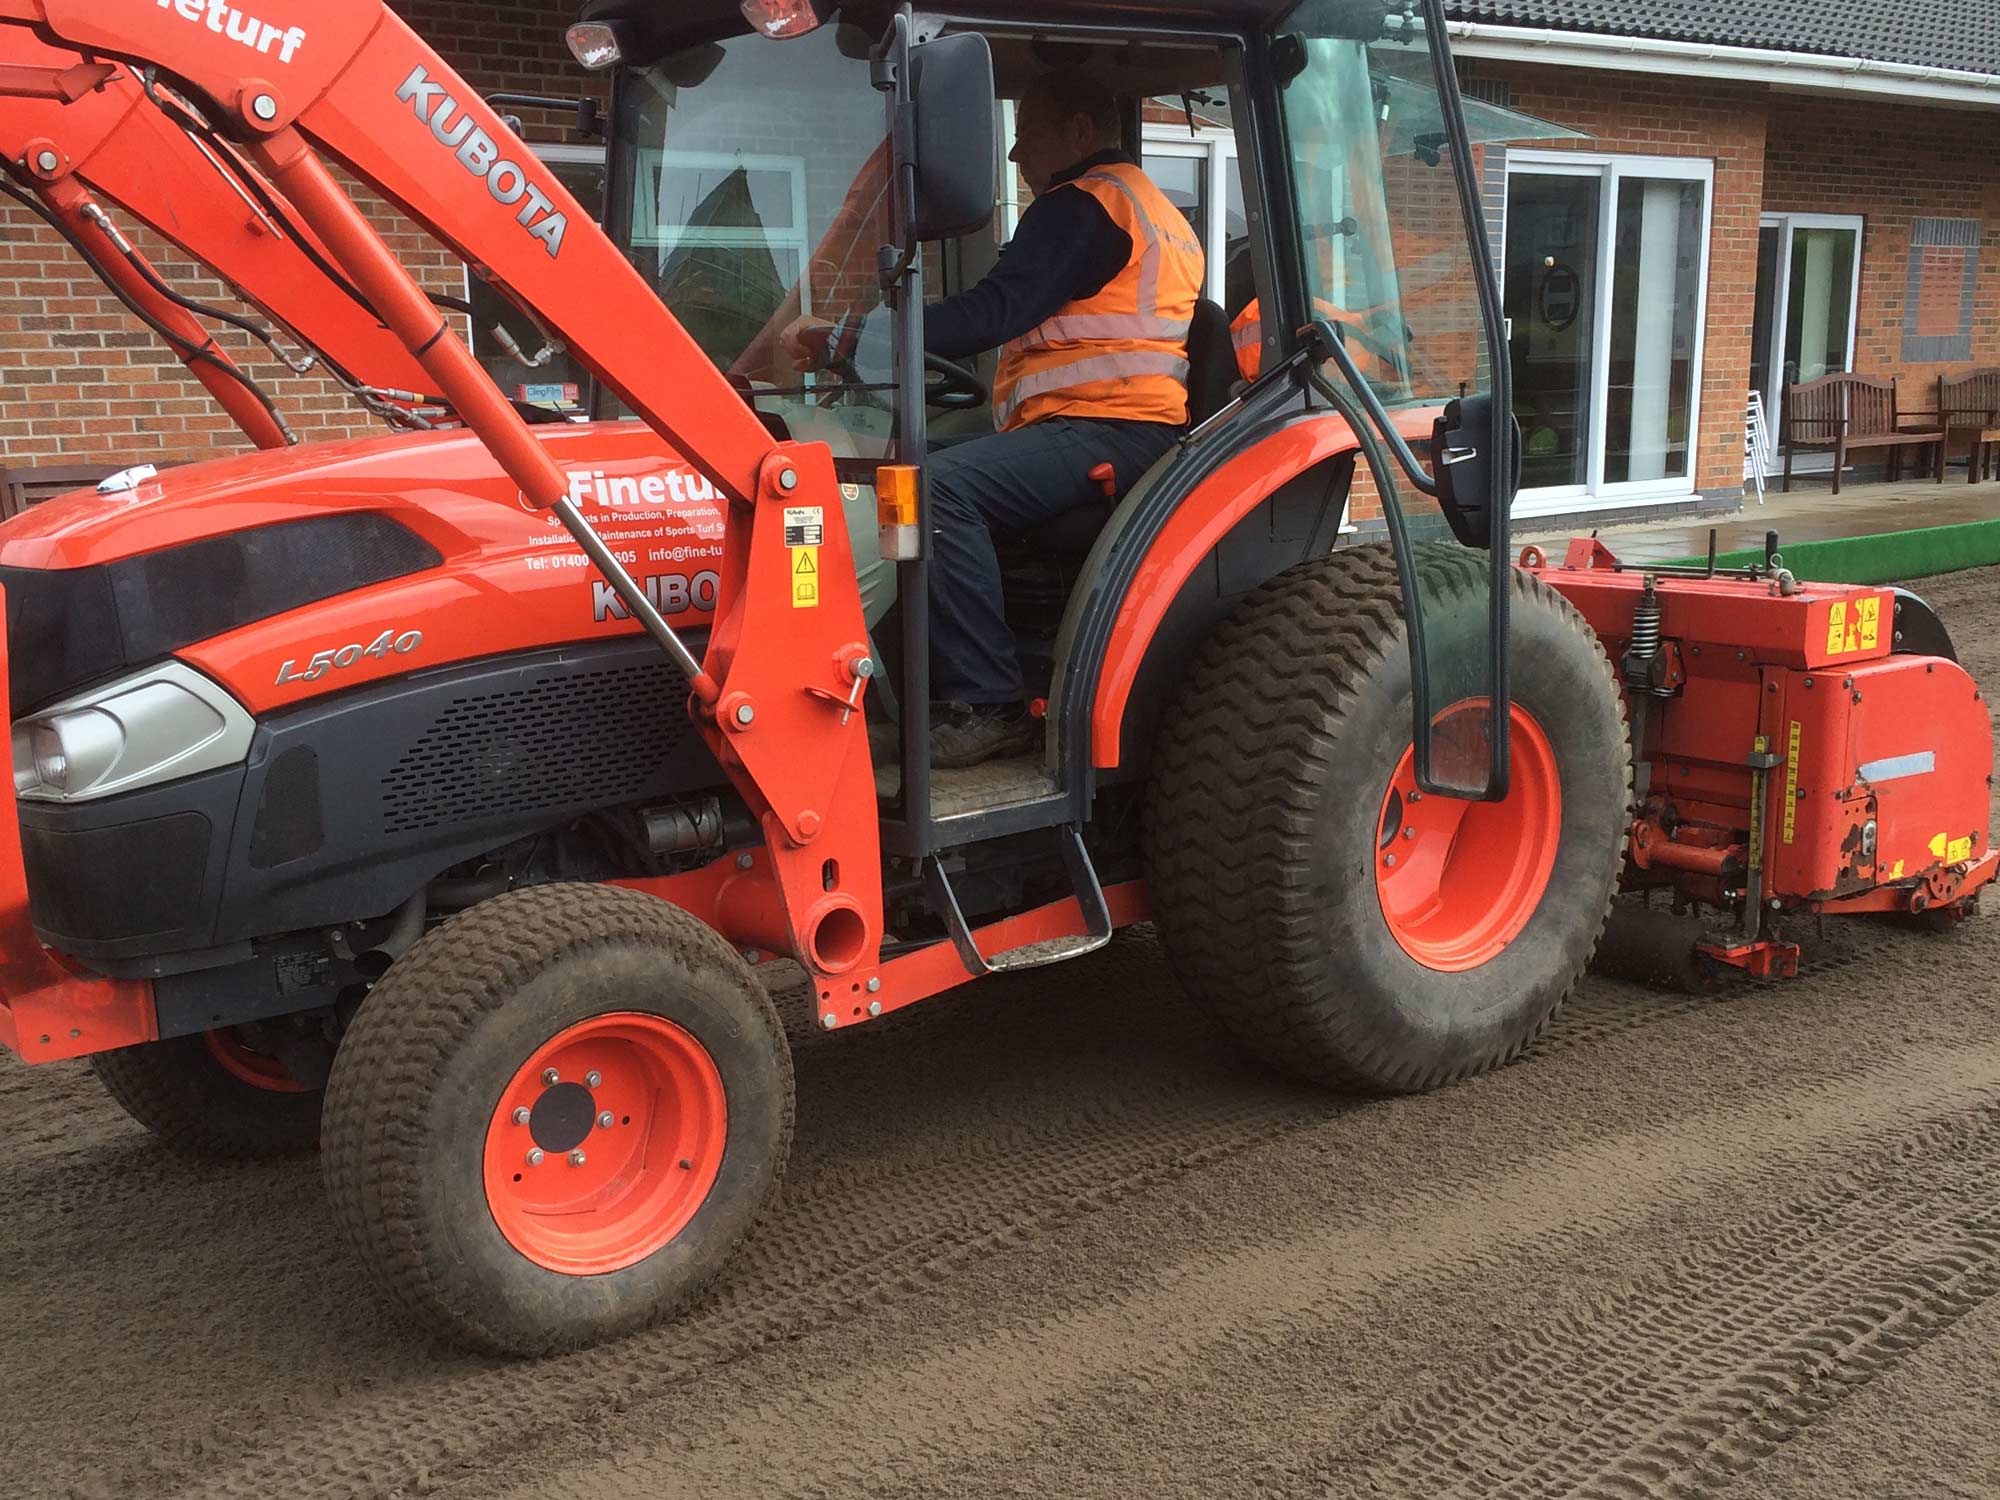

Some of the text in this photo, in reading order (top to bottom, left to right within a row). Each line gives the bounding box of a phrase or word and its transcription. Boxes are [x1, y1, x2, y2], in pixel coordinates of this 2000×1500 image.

[156, 0, 306, 64] eturf
[395, 64, 568, 260] KUBOTA
[566, 469, 727, 508] Finetu
[597, 529, 652, 541] aintenance
[654, 527, 664, 537] of
[665, 526, 696, 538] Sports
[696, 522, 715, 533] Turf
[600, 512, 610, 523] in
[612, 511, 665, 521] Production,
[525, 557, 549, 570] Tel:
[552, 554, 589, 568] 01400
[274, 629, 424, 686] L5040
